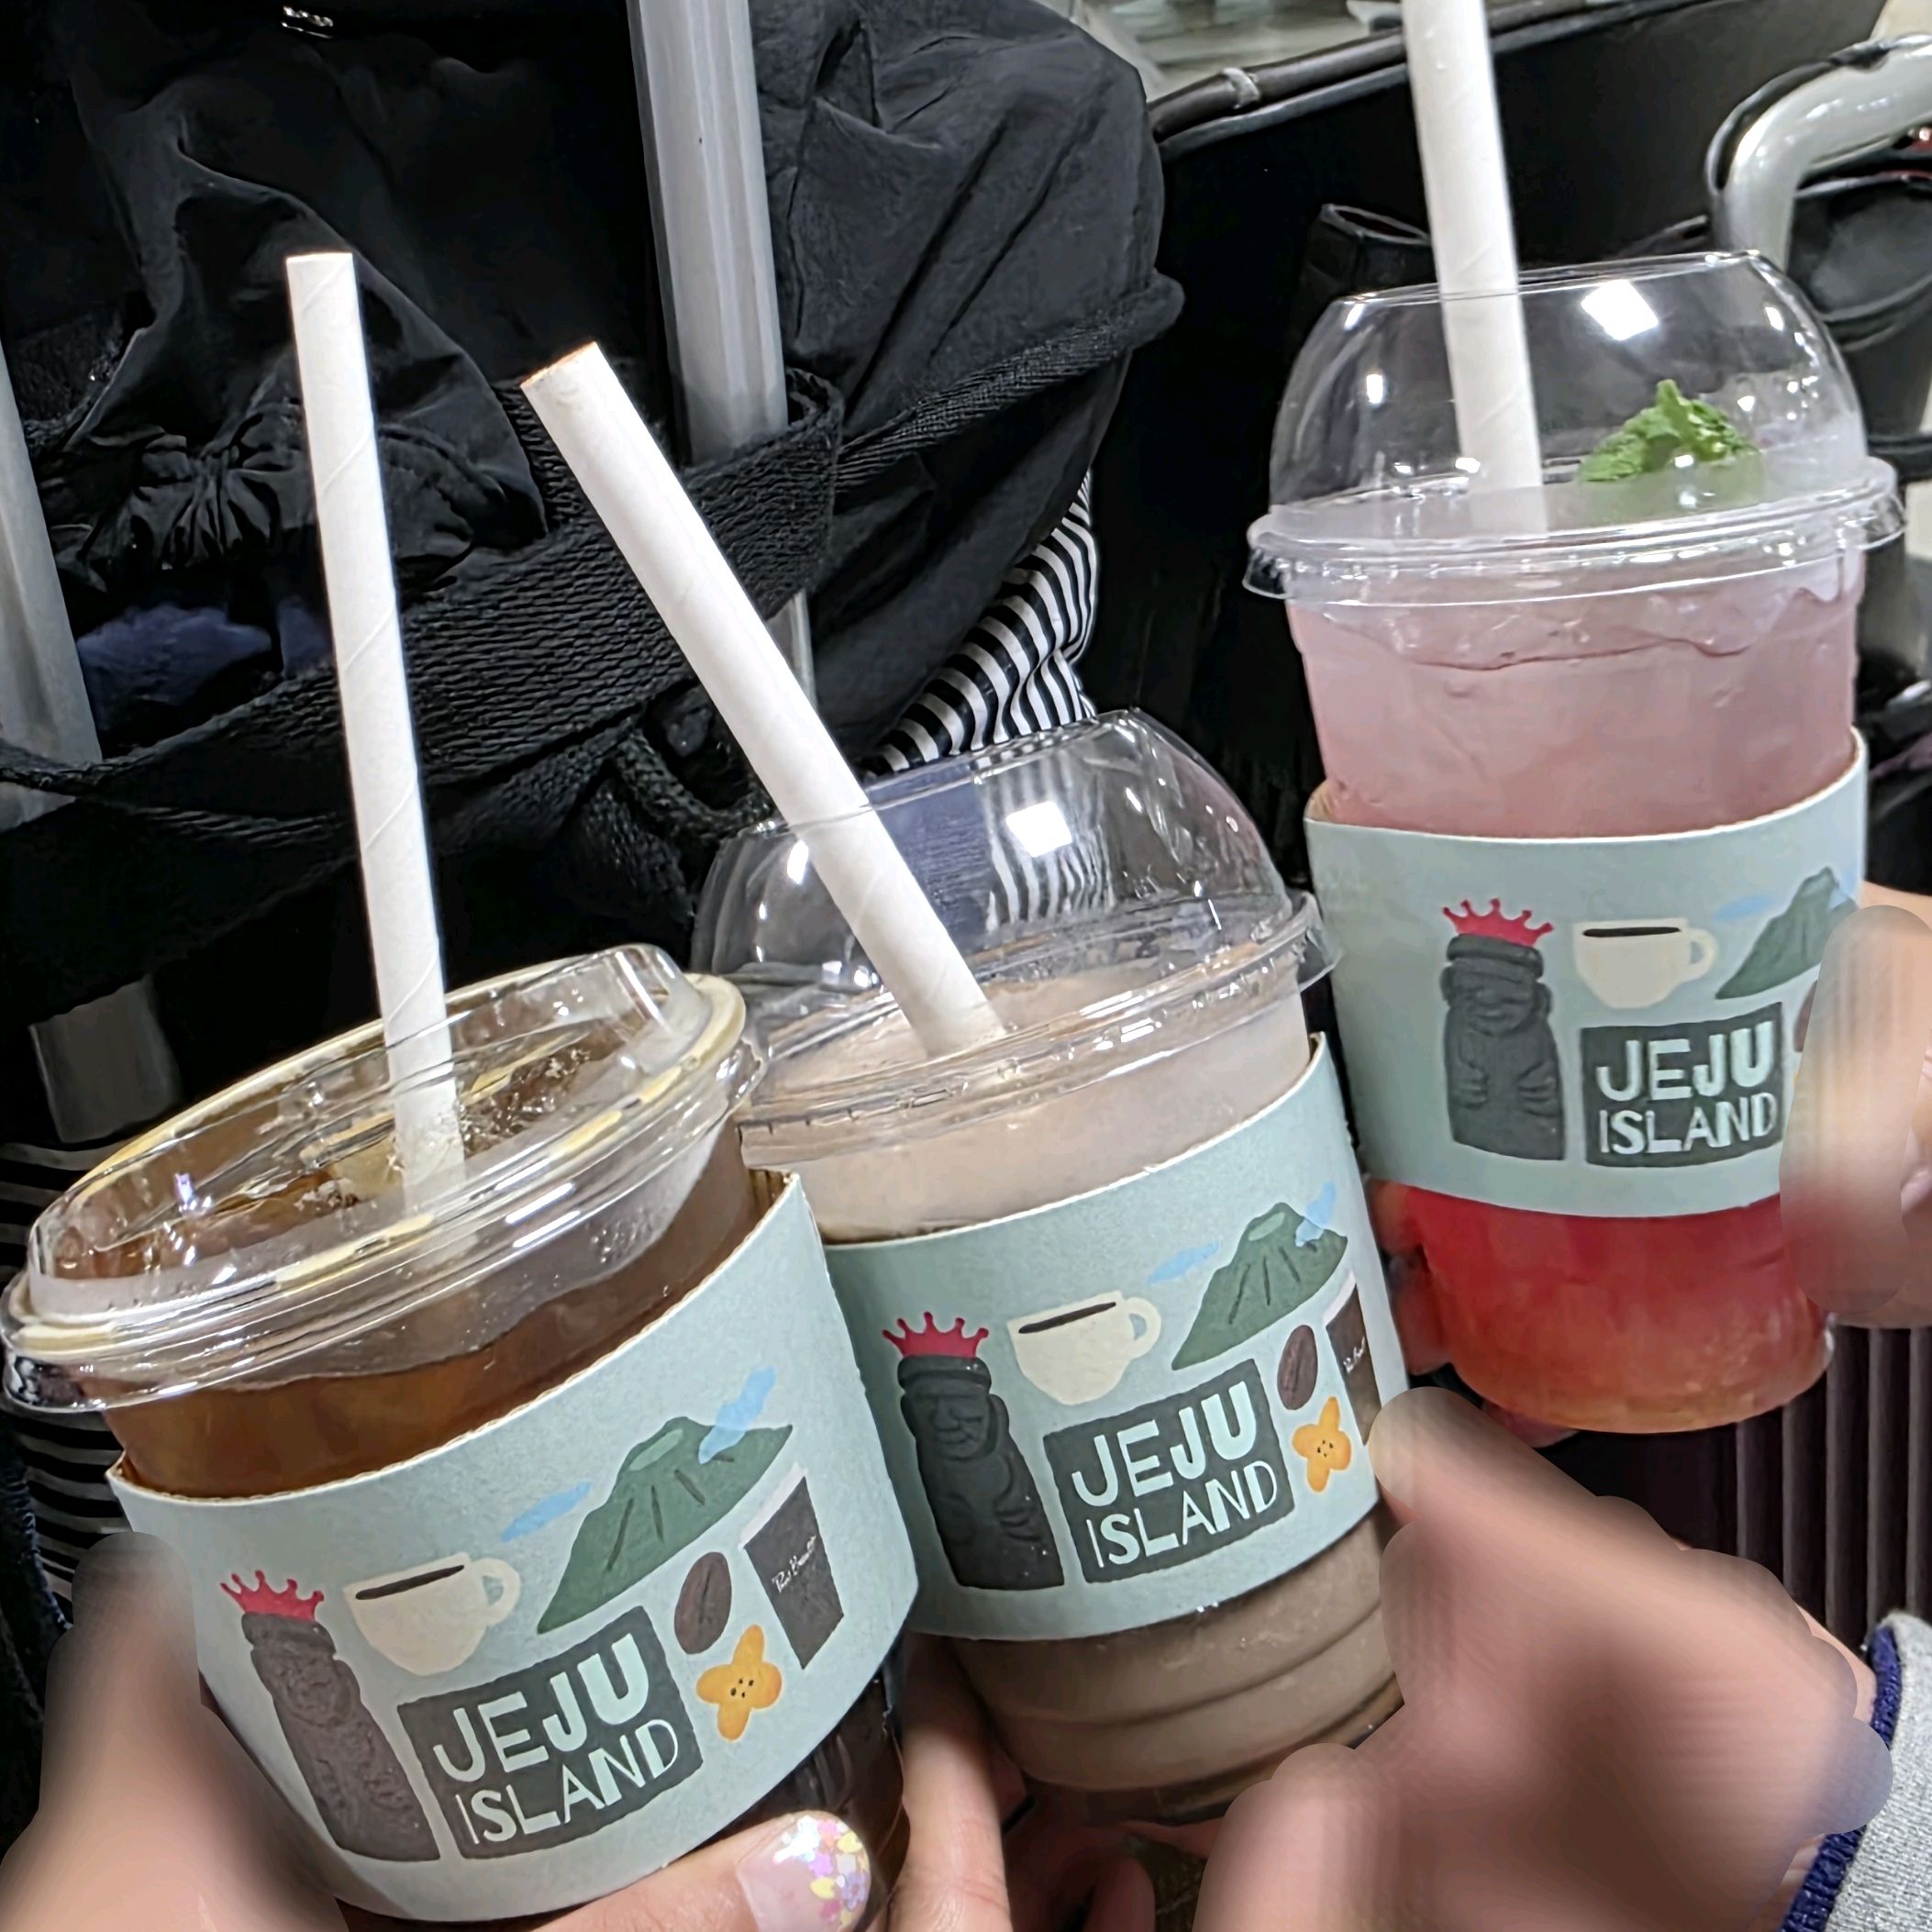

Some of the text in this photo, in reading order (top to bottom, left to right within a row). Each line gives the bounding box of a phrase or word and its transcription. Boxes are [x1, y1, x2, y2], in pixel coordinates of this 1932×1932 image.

[1596, 1021, 1775, 1101] JEJU
[1599, 1093, 1777, 1154] ISLAND
[1071, 1381, 1257, 1506] JEJU
[1086, 1460, 1277, 1567] ISLAND
[433, 1633, 650, 1782] JEJU
[455, 1719, 679, 1844] ISLAND
